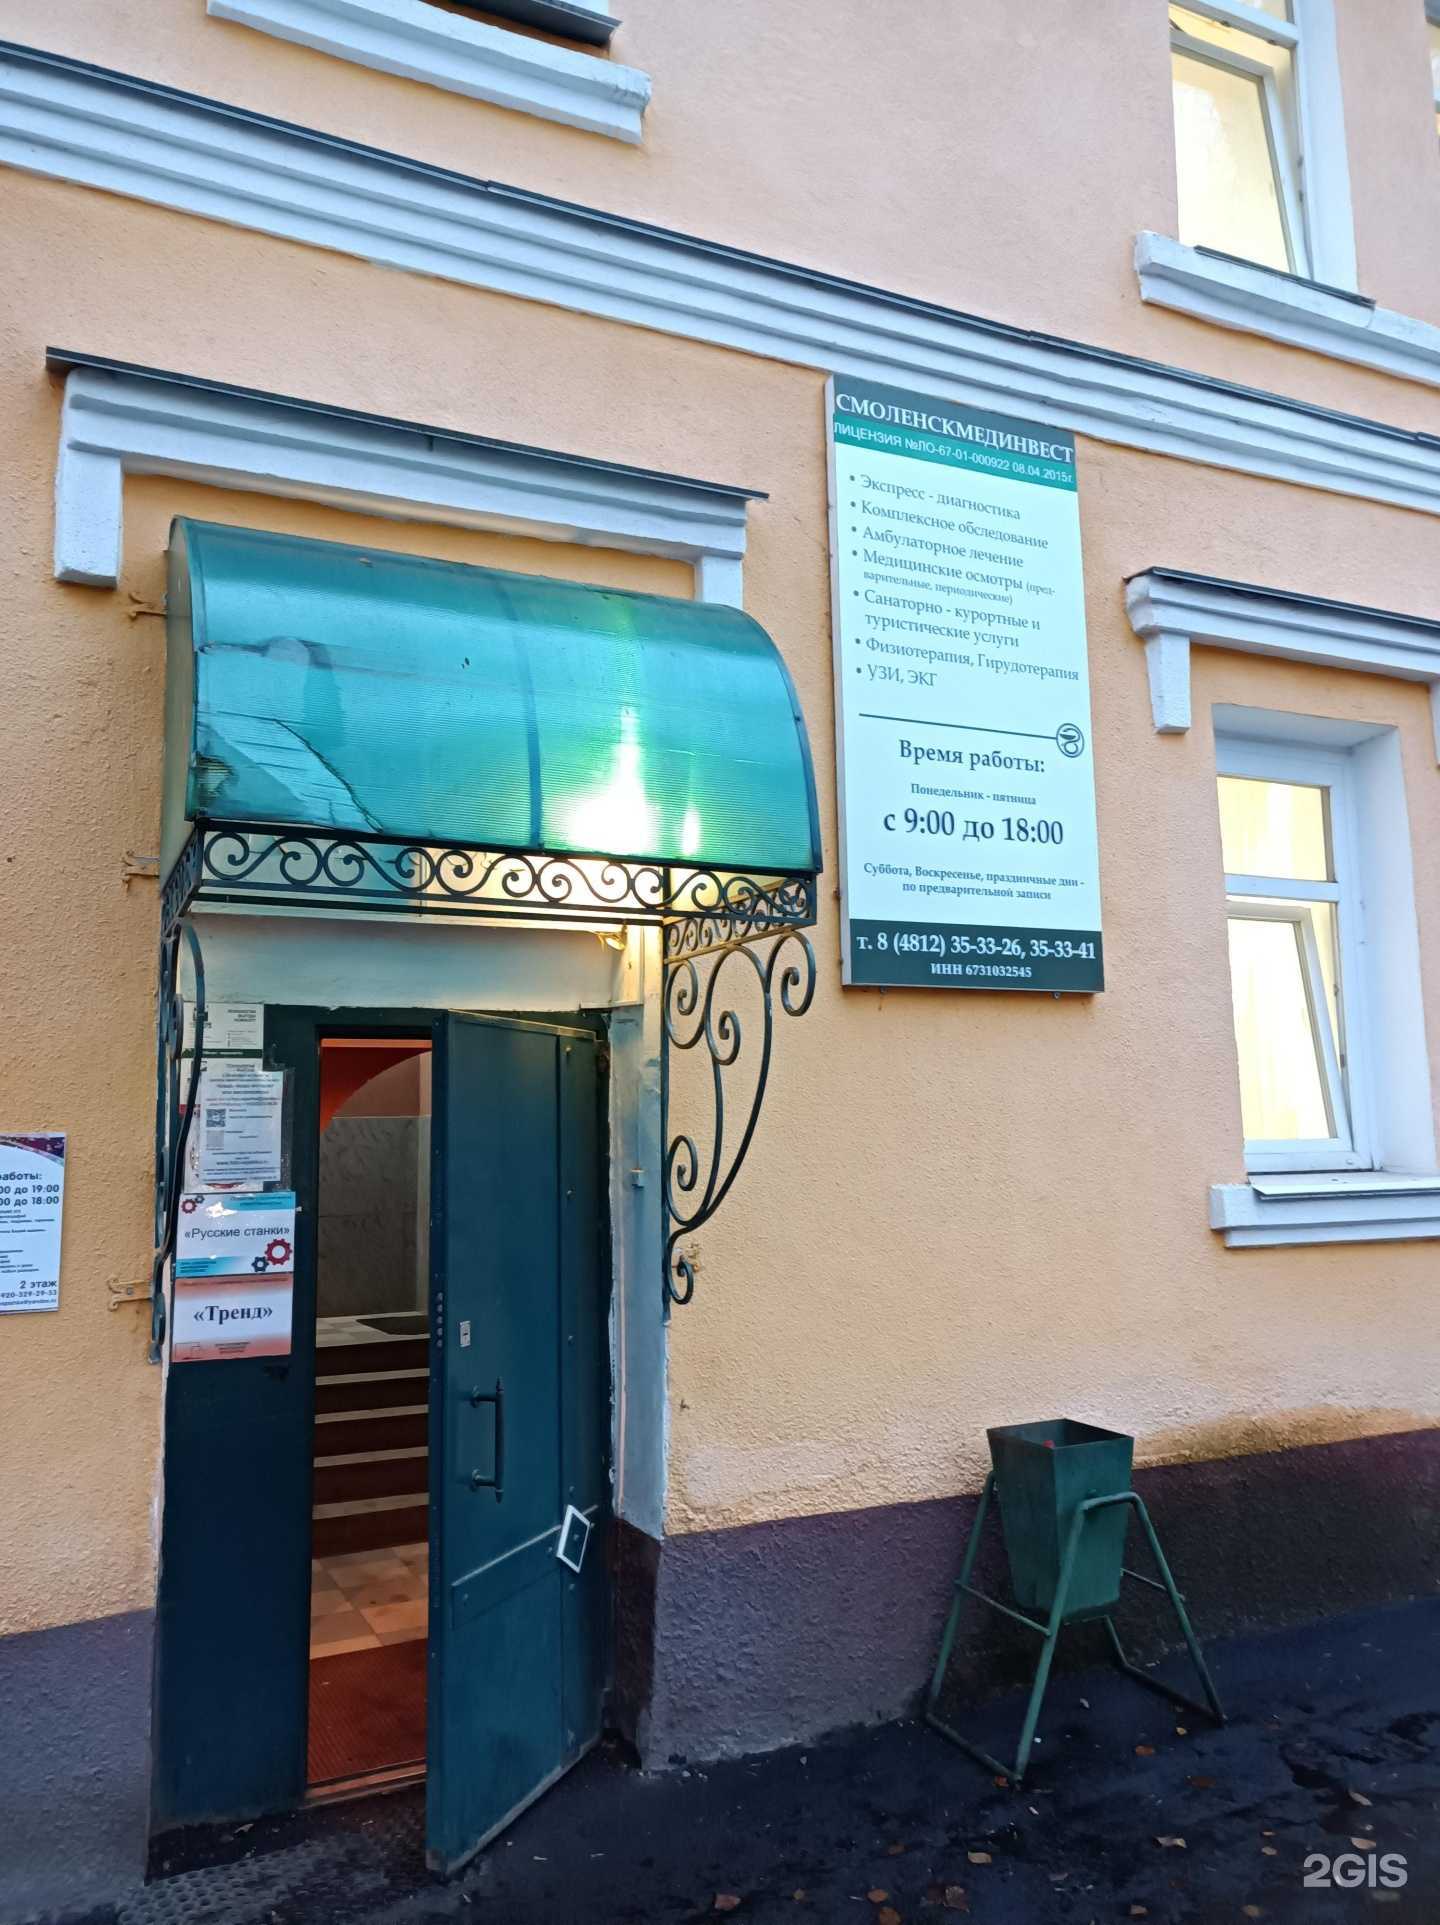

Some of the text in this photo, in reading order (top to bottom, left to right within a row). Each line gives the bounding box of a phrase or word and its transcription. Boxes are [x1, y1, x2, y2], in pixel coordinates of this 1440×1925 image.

[834, 423, 902, 447] ЛИЦЕНЗИЯ
[835, 393, 1074, 464] СМОЛЕНСКМЕДИНВЕСТ
[861, 475, 925, 500] Экспресс
[936, 493, 1020, 520] диагностика
[862, 501, 1048, 549] Комплексное обследование
[863, 527, 1023, 568] Амбулаторное лечение
[863, 549, 962, 579] Медицинские
[966, 572, 1023, 591] осмотры
[865, 590, 942, 615] Санаторно
[955, 607, 1029, 628] курортные
[1032, 621, 1040, 630] и
[865, 614, 1019, 647] туристические услуги
[866, 638, 1079, 681] Физиотерапия, Гирудотерапия
[867, 663, 937, 687] УЗИ, ЭКГ
[899, 739, 1045, 773] Время работы:
[912, 784, 984, 800] Понедельник
[993, 793, 1036, 805] пятница
[904, 809, 955, 836] 9:00
[963, 821, 994, 842] до
[1002, 818, 1064, 844] 18:00
[864, 863, 912, 877] Суббота,
[915, 866, 983, 882] Воскресенье,
[987, 872, 1056, 887] праздничные
[1059, 877, 1078, 887] дни
[902, 883, 1051, 900] по предварительной записи
[857, 933, 1095, 959] т. 8 (4812) 35-33-26, 35-33-41
[931, 963, 1031, 977] ИНН 6731032545
[14, 1187, 28, 1195] до
[14, 1199, 28, 1207] до
[32, 1196, 59, 1204] 18:00
[185, 1227, 289, 1240] «Русские станки»
[20, 1281, 26, 1289] 2
[194, 1306, 273, 1324] «Тренд»
